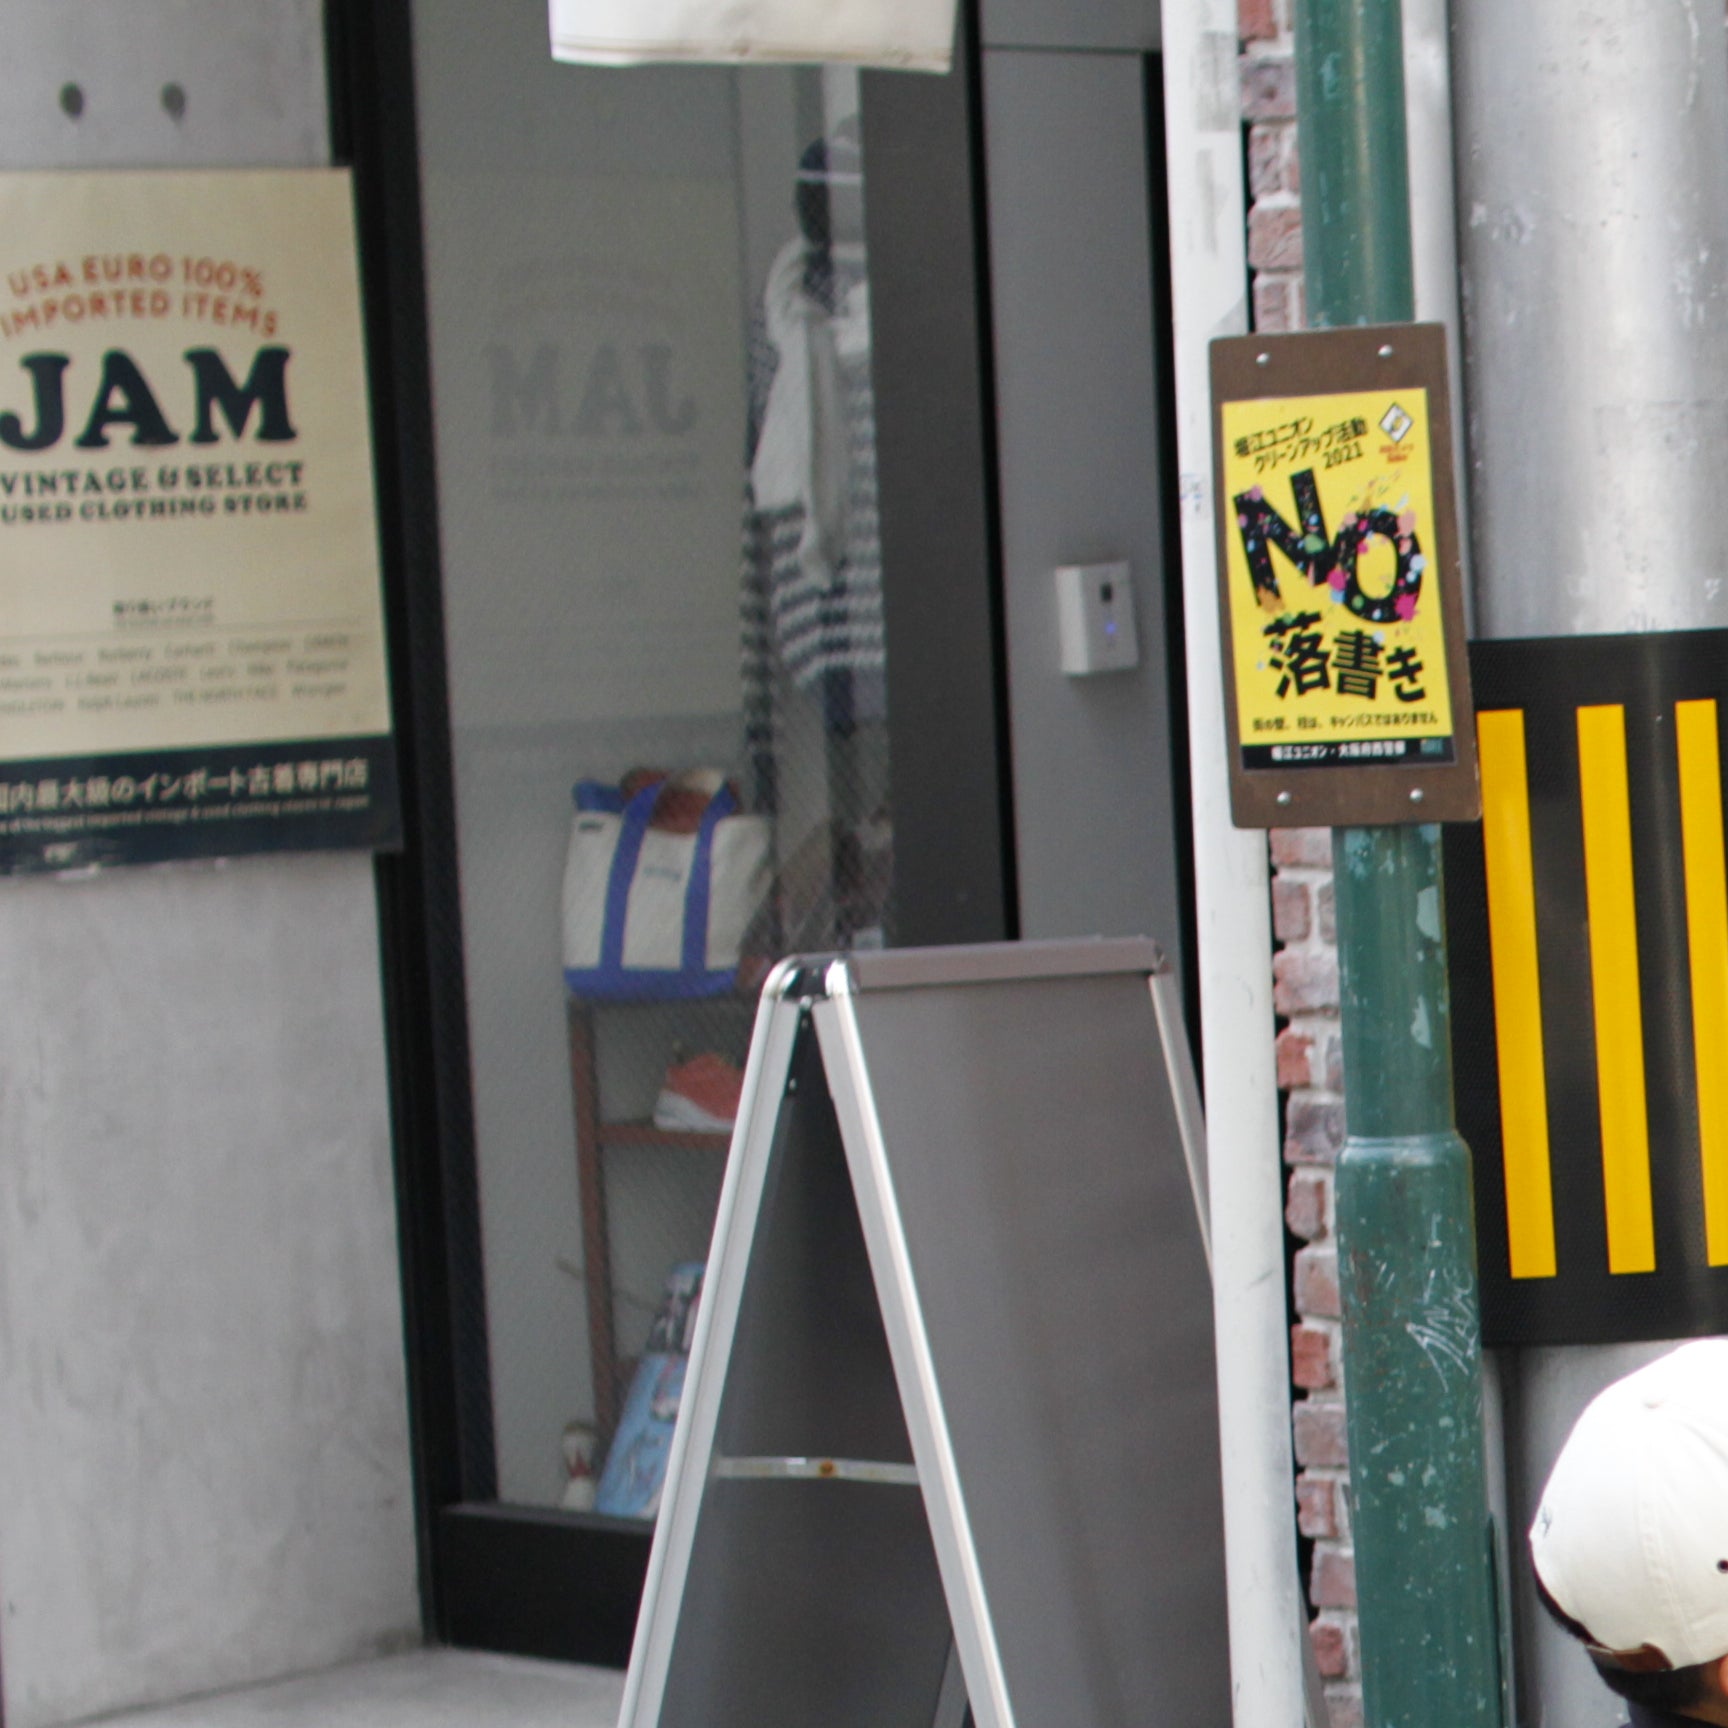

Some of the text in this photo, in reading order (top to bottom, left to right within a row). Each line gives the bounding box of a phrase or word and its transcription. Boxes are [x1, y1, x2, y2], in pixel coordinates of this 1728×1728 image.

[8, 252, 264, 297] USA EURO 100%
[0, 289, 278, 338] IMPORTED ITEMS
[0, 344, 298, 451] JAM
[0, 459, 304, 497] VINTAGE & SELECT
[1321, 441, 1364, 470] 2021
[1, 490, 309, 524] USED CLOTHING STORE
[1263, 610, 1427, 704] 落書き
